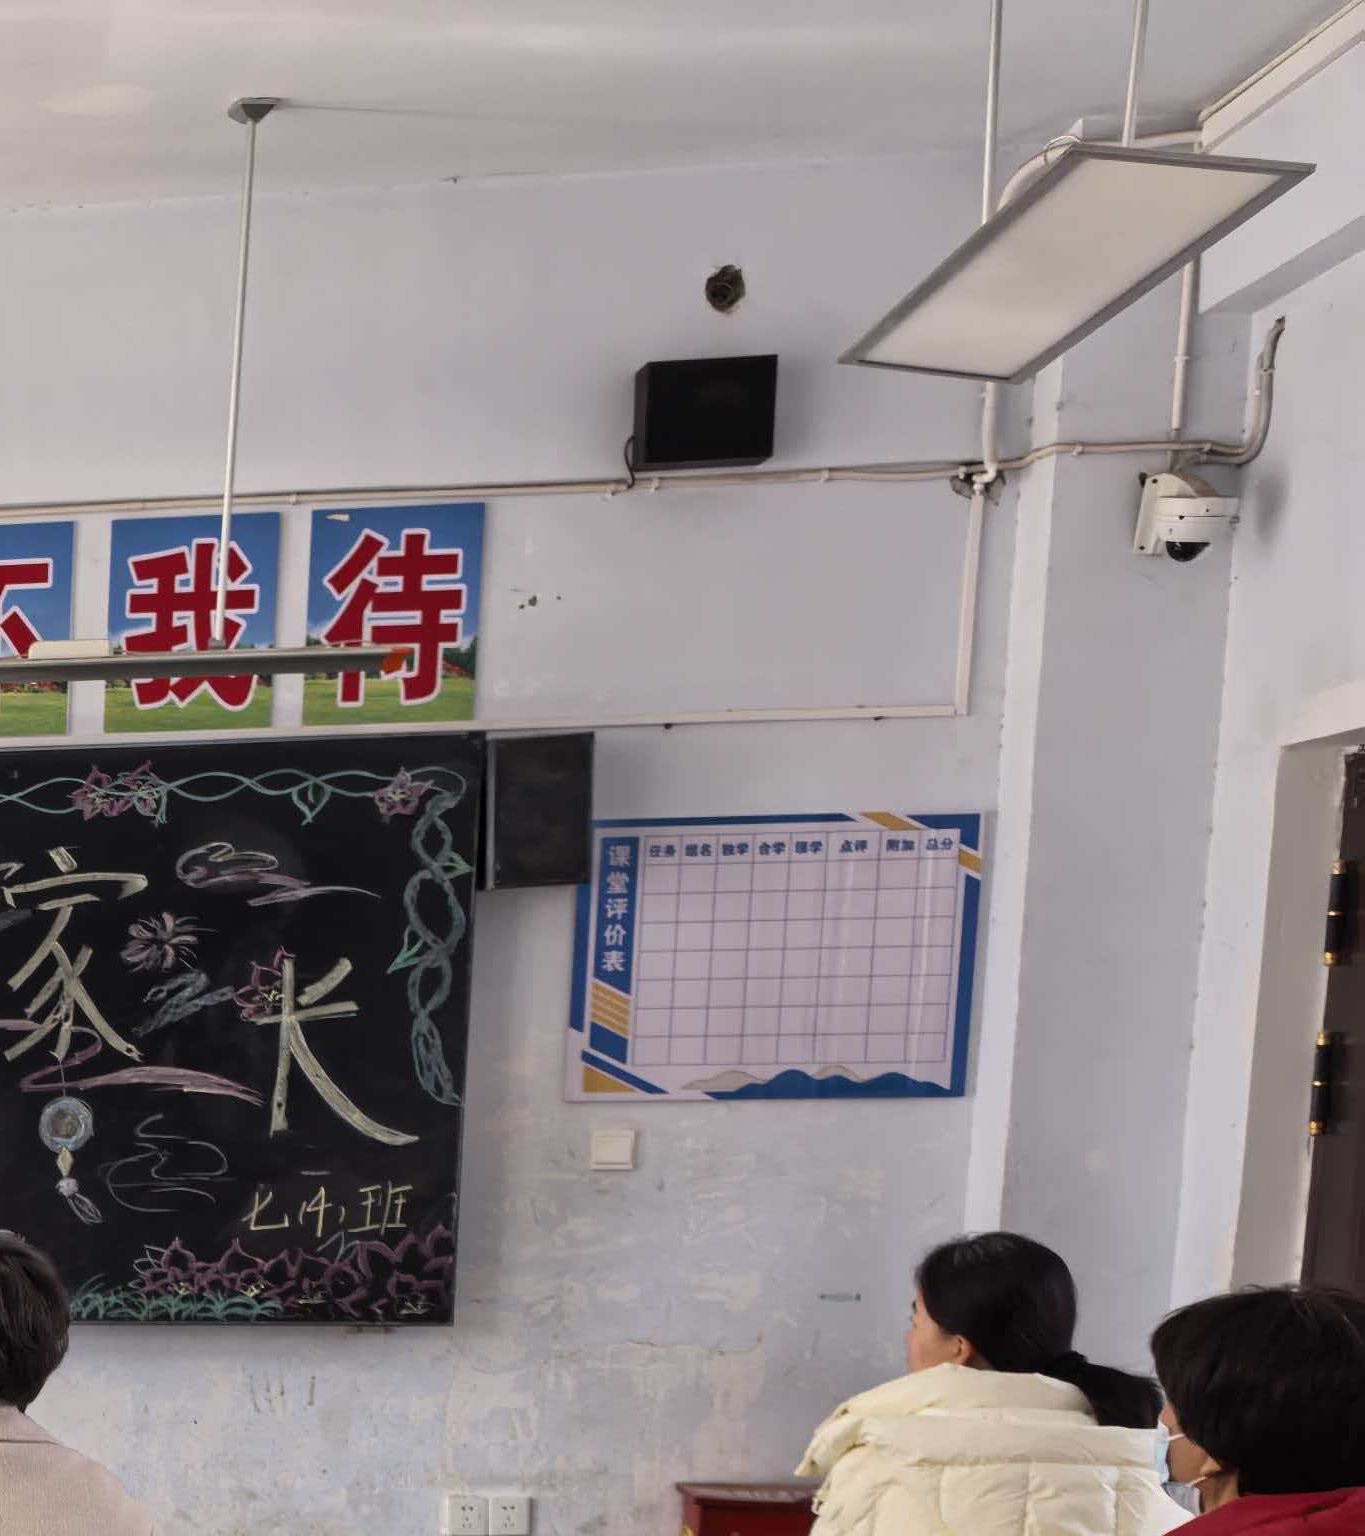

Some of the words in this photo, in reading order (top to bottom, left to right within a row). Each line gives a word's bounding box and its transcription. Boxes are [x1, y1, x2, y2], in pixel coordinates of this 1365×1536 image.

[600, 844, 633, 973] 课堂评价表
